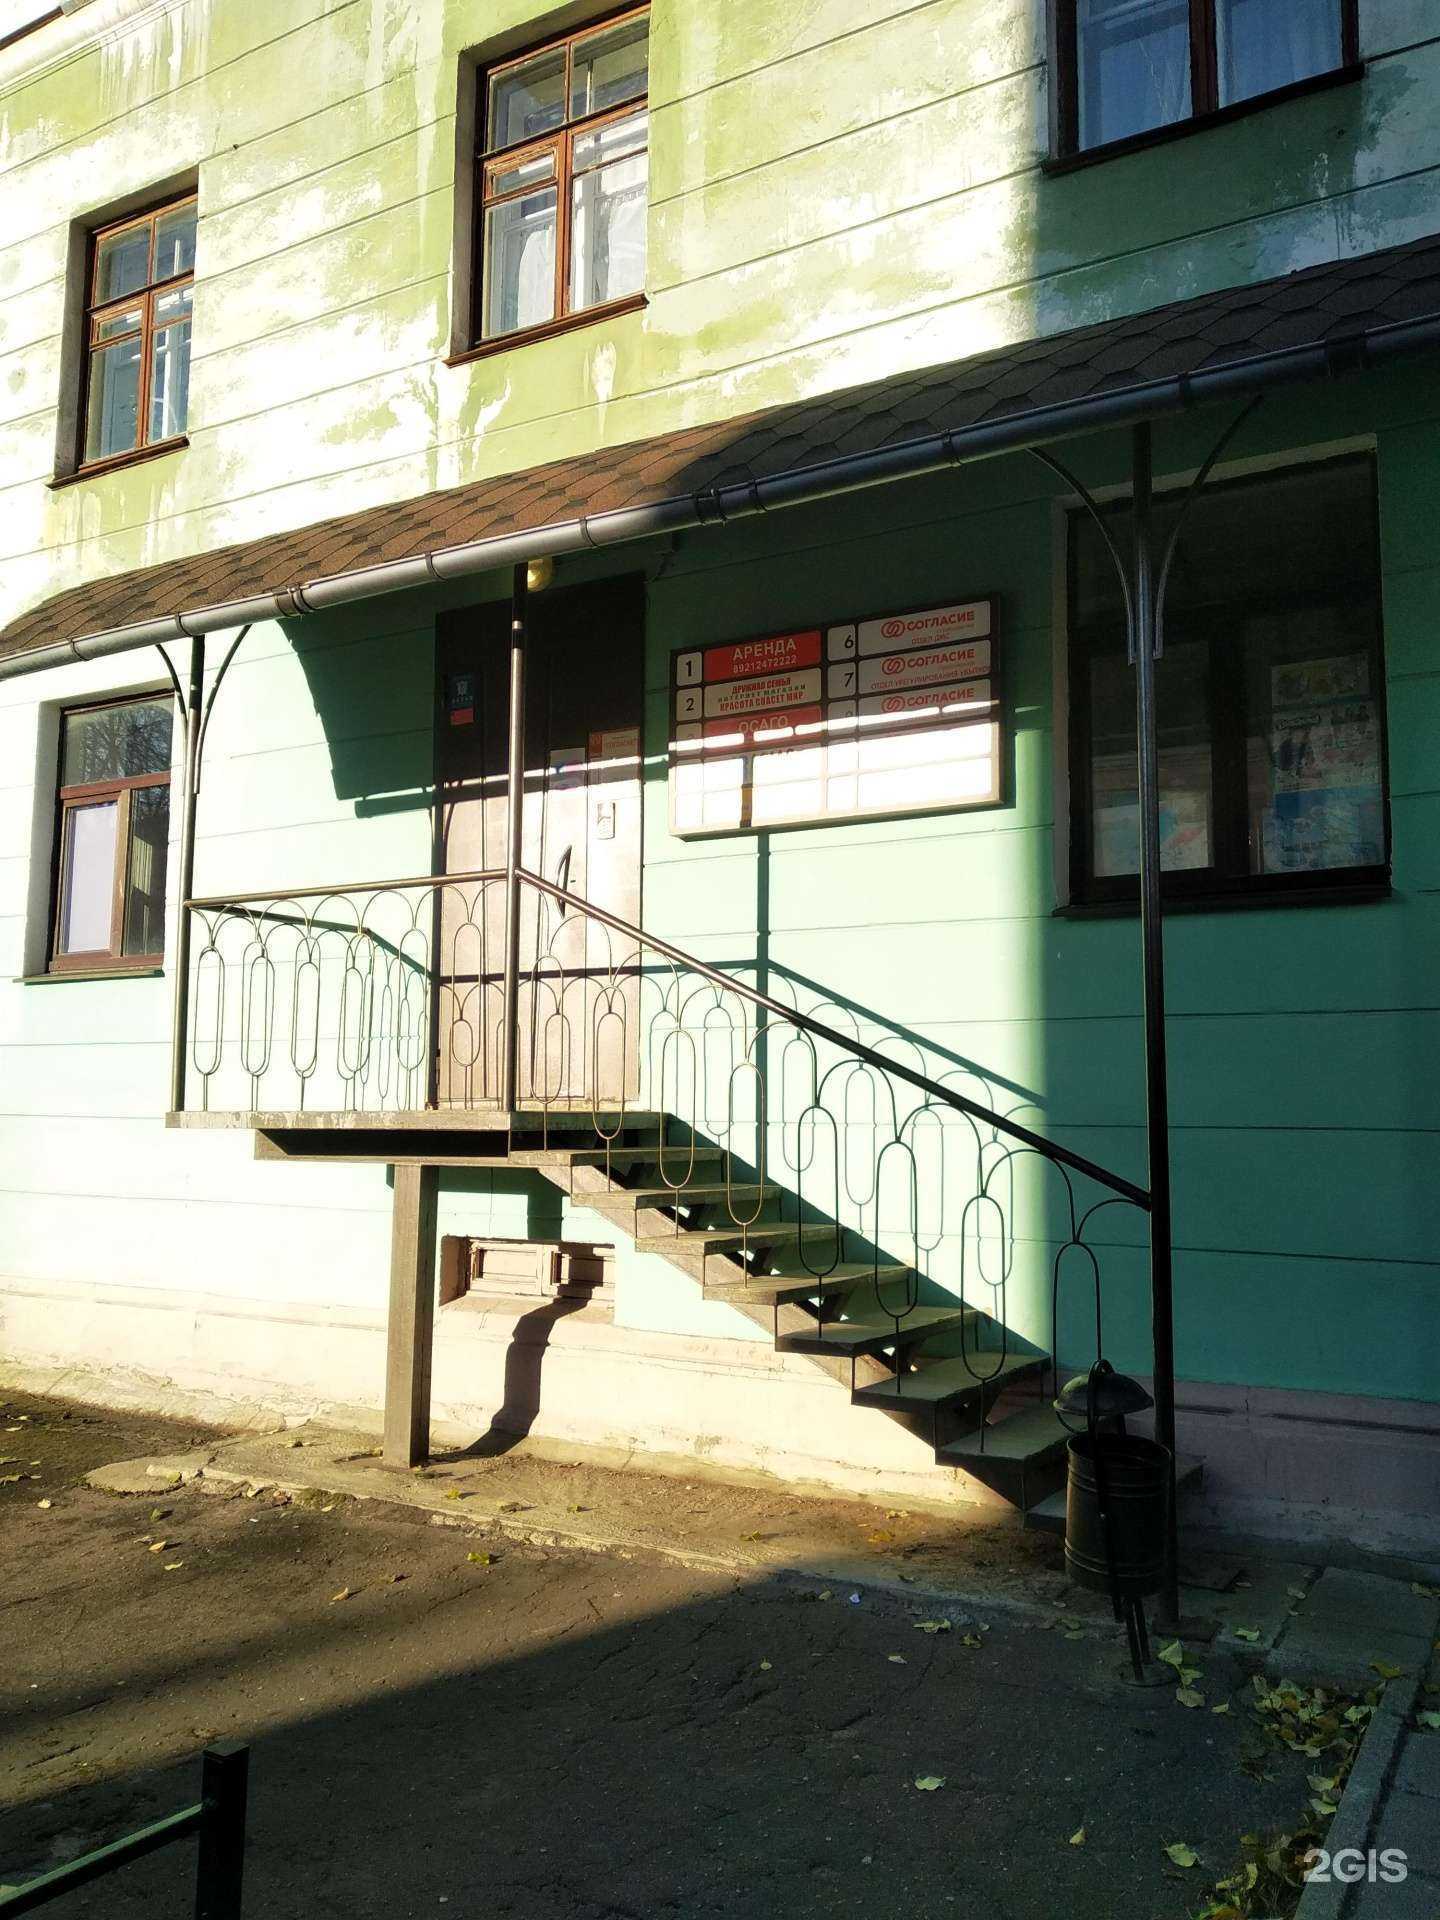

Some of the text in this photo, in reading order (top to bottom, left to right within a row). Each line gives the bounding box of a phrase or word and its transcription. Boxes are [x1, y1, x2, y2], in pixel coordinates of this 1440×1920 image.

[907, 610, 976, 631] СОГЛАСИЕ
[733, 638, 798, 661] АРЕНДА
[844, 634, 854, 649] 6
[907, 648, 976, 668] СОГЛАСИЕ
[685, 660, 693, 677] 1
[844, 671, 854, 688] 7
[685, 697, 695, 712] 2
[719, 698, 754, 712] КРАСОТА
[786, 690, 804, 702] МИР
[907, 687, 976, 707] СОГЛАСИЕ
[738, 715, 789, 734] ОСАГО
